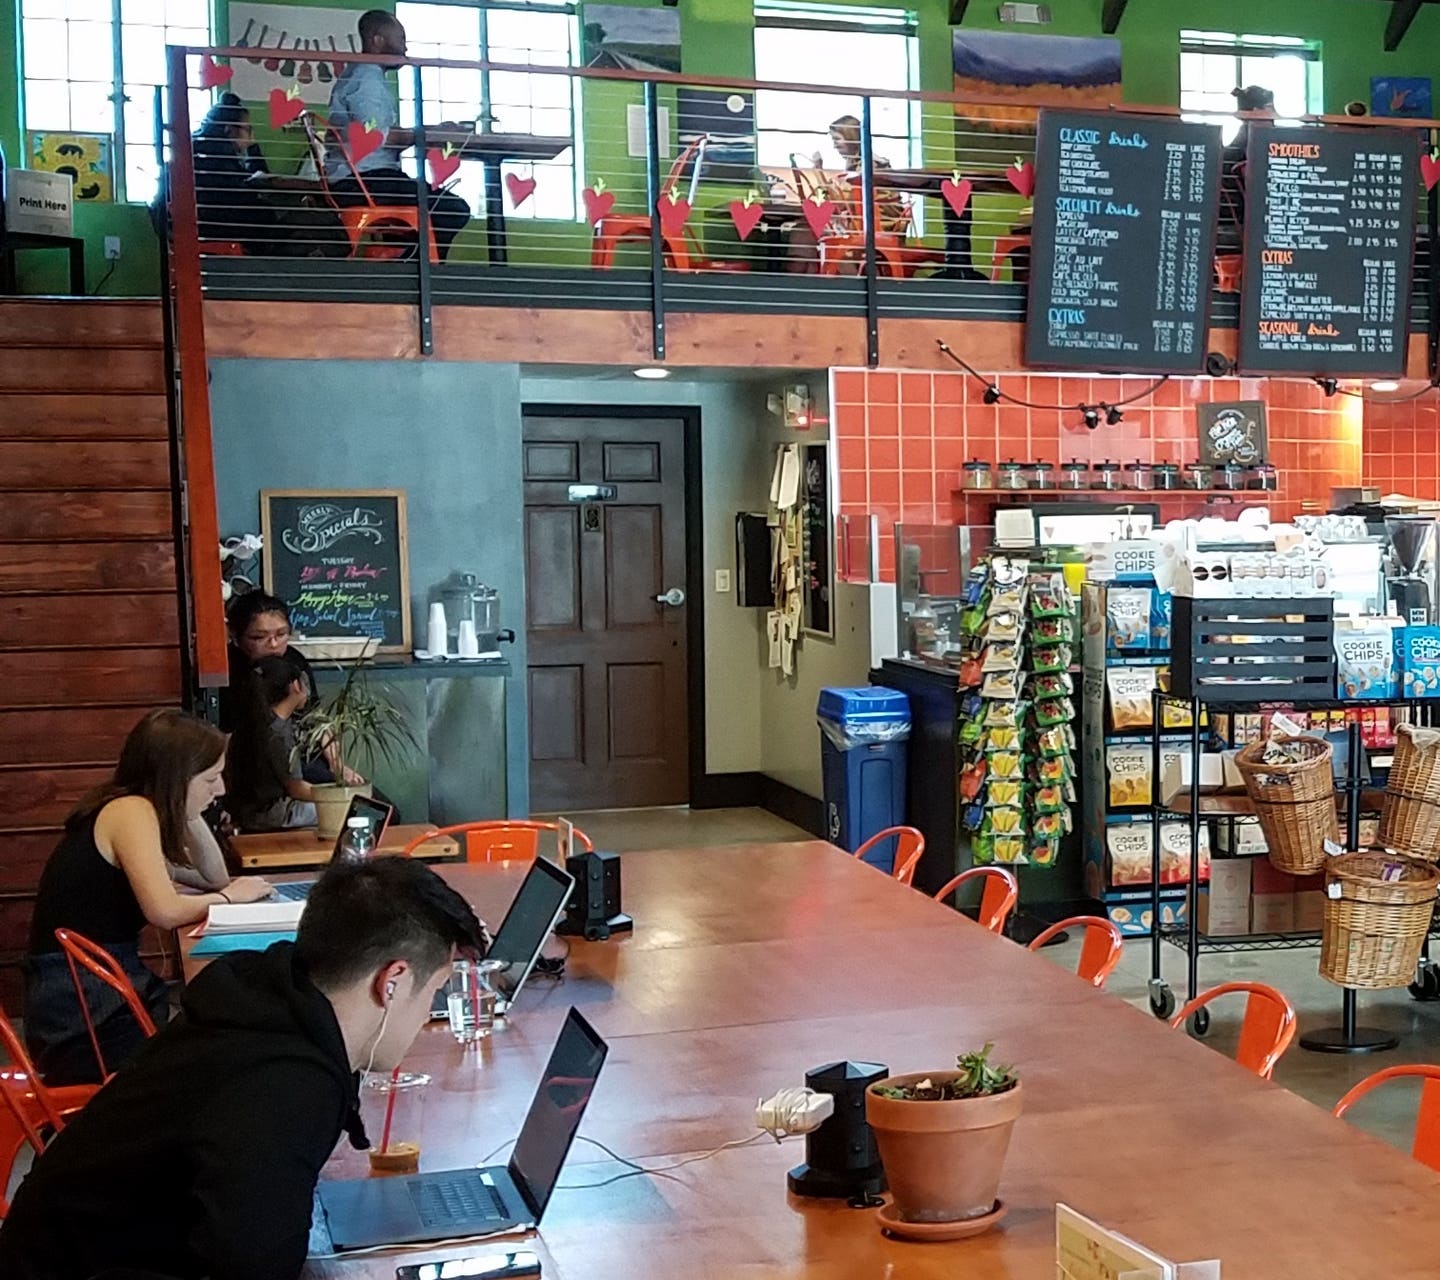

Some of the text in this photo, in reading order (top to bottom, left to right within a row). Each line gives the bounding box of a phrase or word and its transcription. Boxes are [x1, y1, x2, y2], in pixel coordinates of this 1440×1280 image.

[1060, 128, 1100, 144] CLASSIC
[1268, 143, 1320, 158] SMOOTHIES
[20, 197, 67, 211] Print Here
[1262, 250, 1293, 264] EXTRAS
[1048, 308, 1086, 324] EXTRAS
[1259, 321, 1302, 335] SEASONAL
[301, 506, 334, 525] WEEKLY
[301, 507, 369, 552] Specials
[1114, 551, 1155, 559] COOKIE
[321, 557, 355, 565] TUESDAY
[1114, 561, 1155, 571] CHIPS
[1343, 641, 1383, 650] COOKIE
[1344, 650, 1383, 660] CHIPS
[1115, 678, 1152, 686] COOKIE
[1114, 763, 1145, 773] CHIPS
[1114, 836, 1146, 844] COOKIE
[1116, 844, 1148, 852] CHIPS
